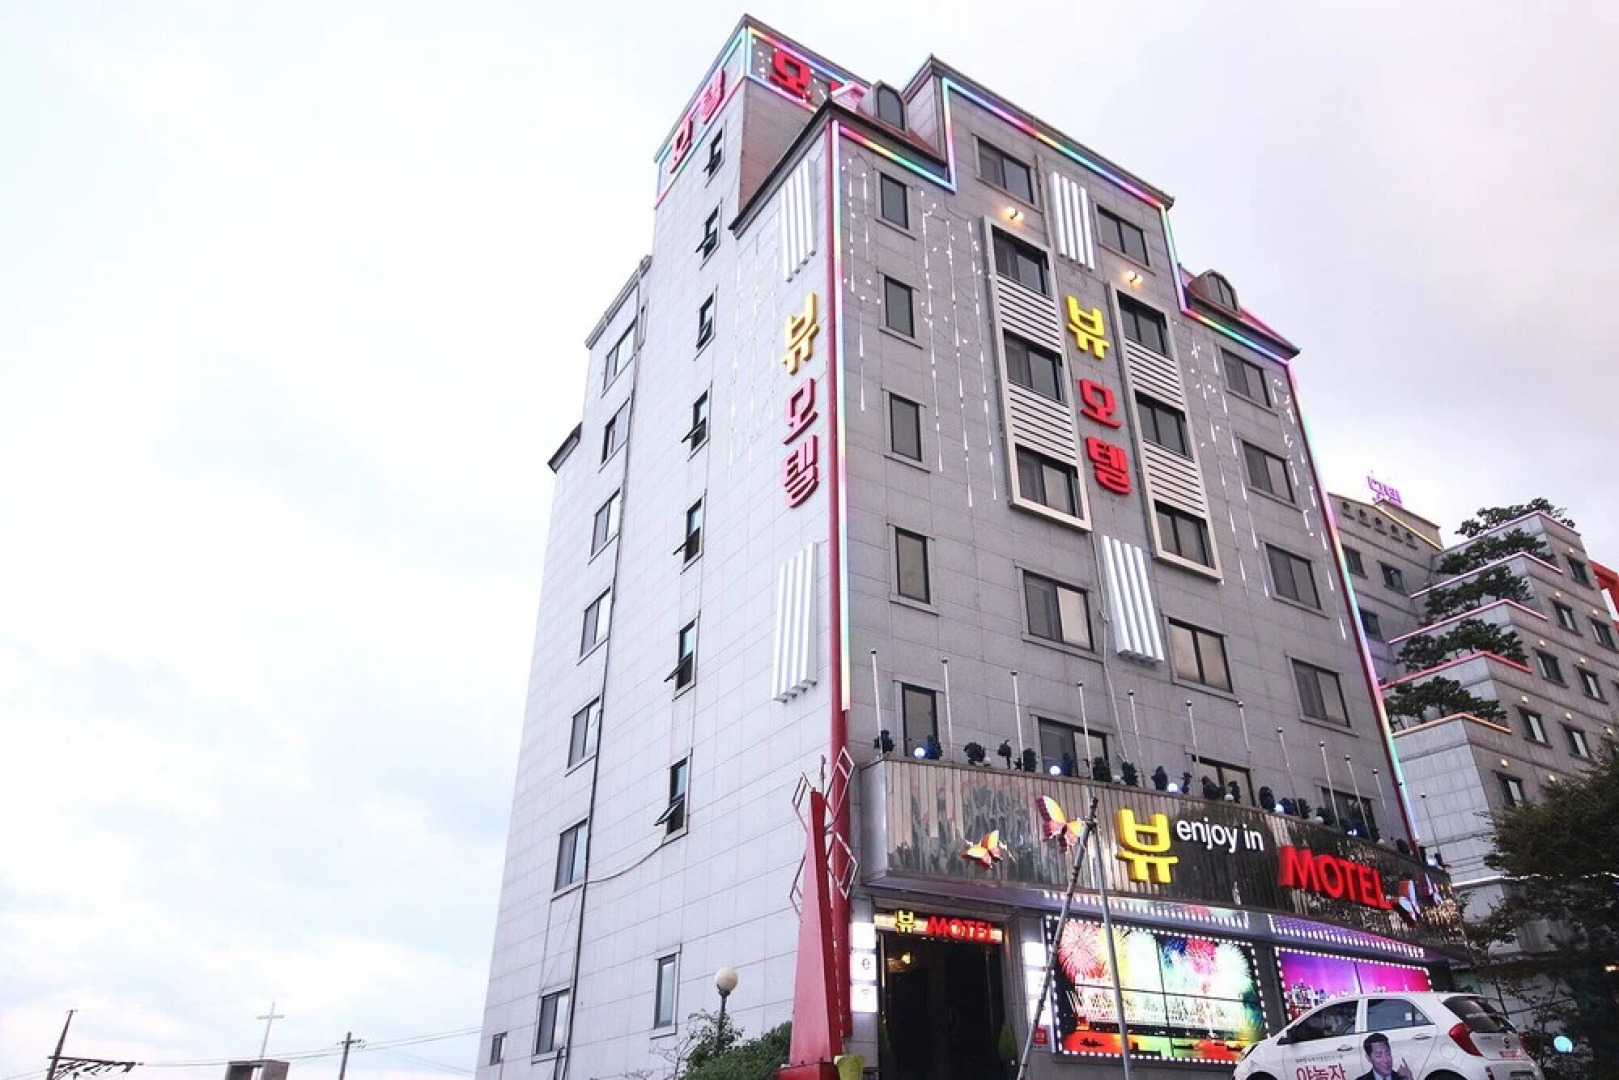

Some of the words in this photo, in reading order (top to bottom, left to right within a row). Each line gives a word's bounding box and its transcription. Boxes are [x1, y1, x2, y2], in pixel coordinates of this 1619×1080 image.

[782, 291, 820, 376] 뷰
[1067, 295, 1110, 359] 뷰
[783, 377, 820, 508] 모텔
[1079, 378, 1133, 495] 모텔
[1115, 808, 1179, 884] 뷰
[1176, 816, 1238, 854] enjoy
[1243, 823, 1265, 853] in
[1278, 844, 1396, 911] MOTEL
[895, 909, 916, 934] 뷰
[926, 915, 998, 943] MOTEL
